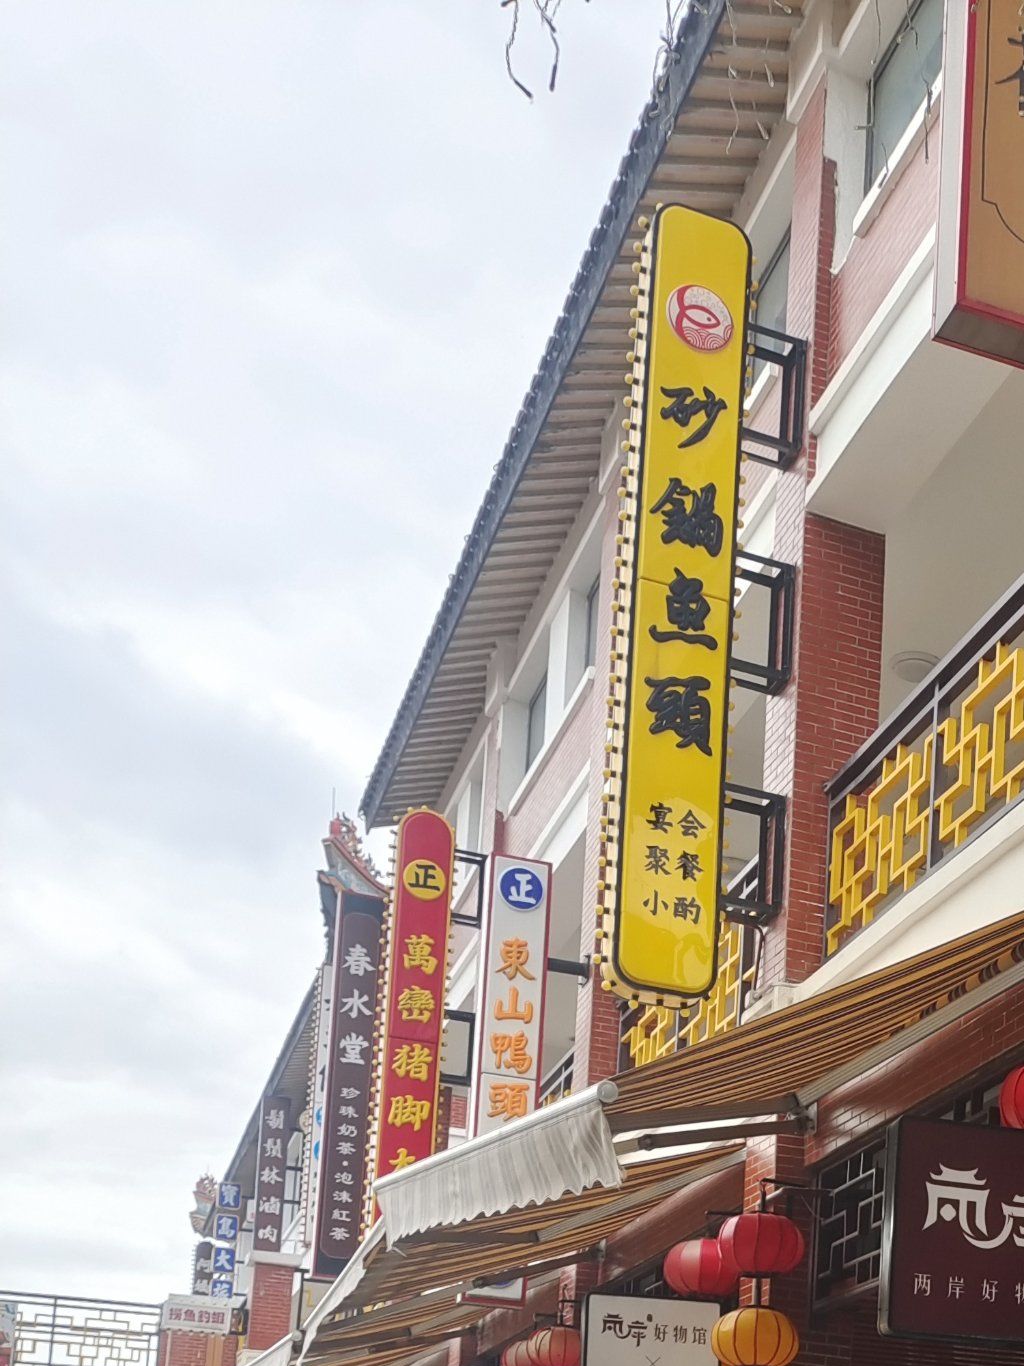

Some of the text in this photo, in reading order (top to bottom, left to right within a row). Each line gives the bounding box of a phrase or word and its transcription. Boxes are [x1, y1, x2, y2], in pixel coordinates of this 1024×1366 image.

[646, 802, 707, 839] 宴会
[407, 863, 441, 892] 正
[644, 845, 704, 882] 聚餐
[508, 873, 537, 904] 正
[642, 889, 702, 925] 小酌
[339, 943, 377, 1065] 春水堂
[653, 1323, 708, 1346] 好物馆
